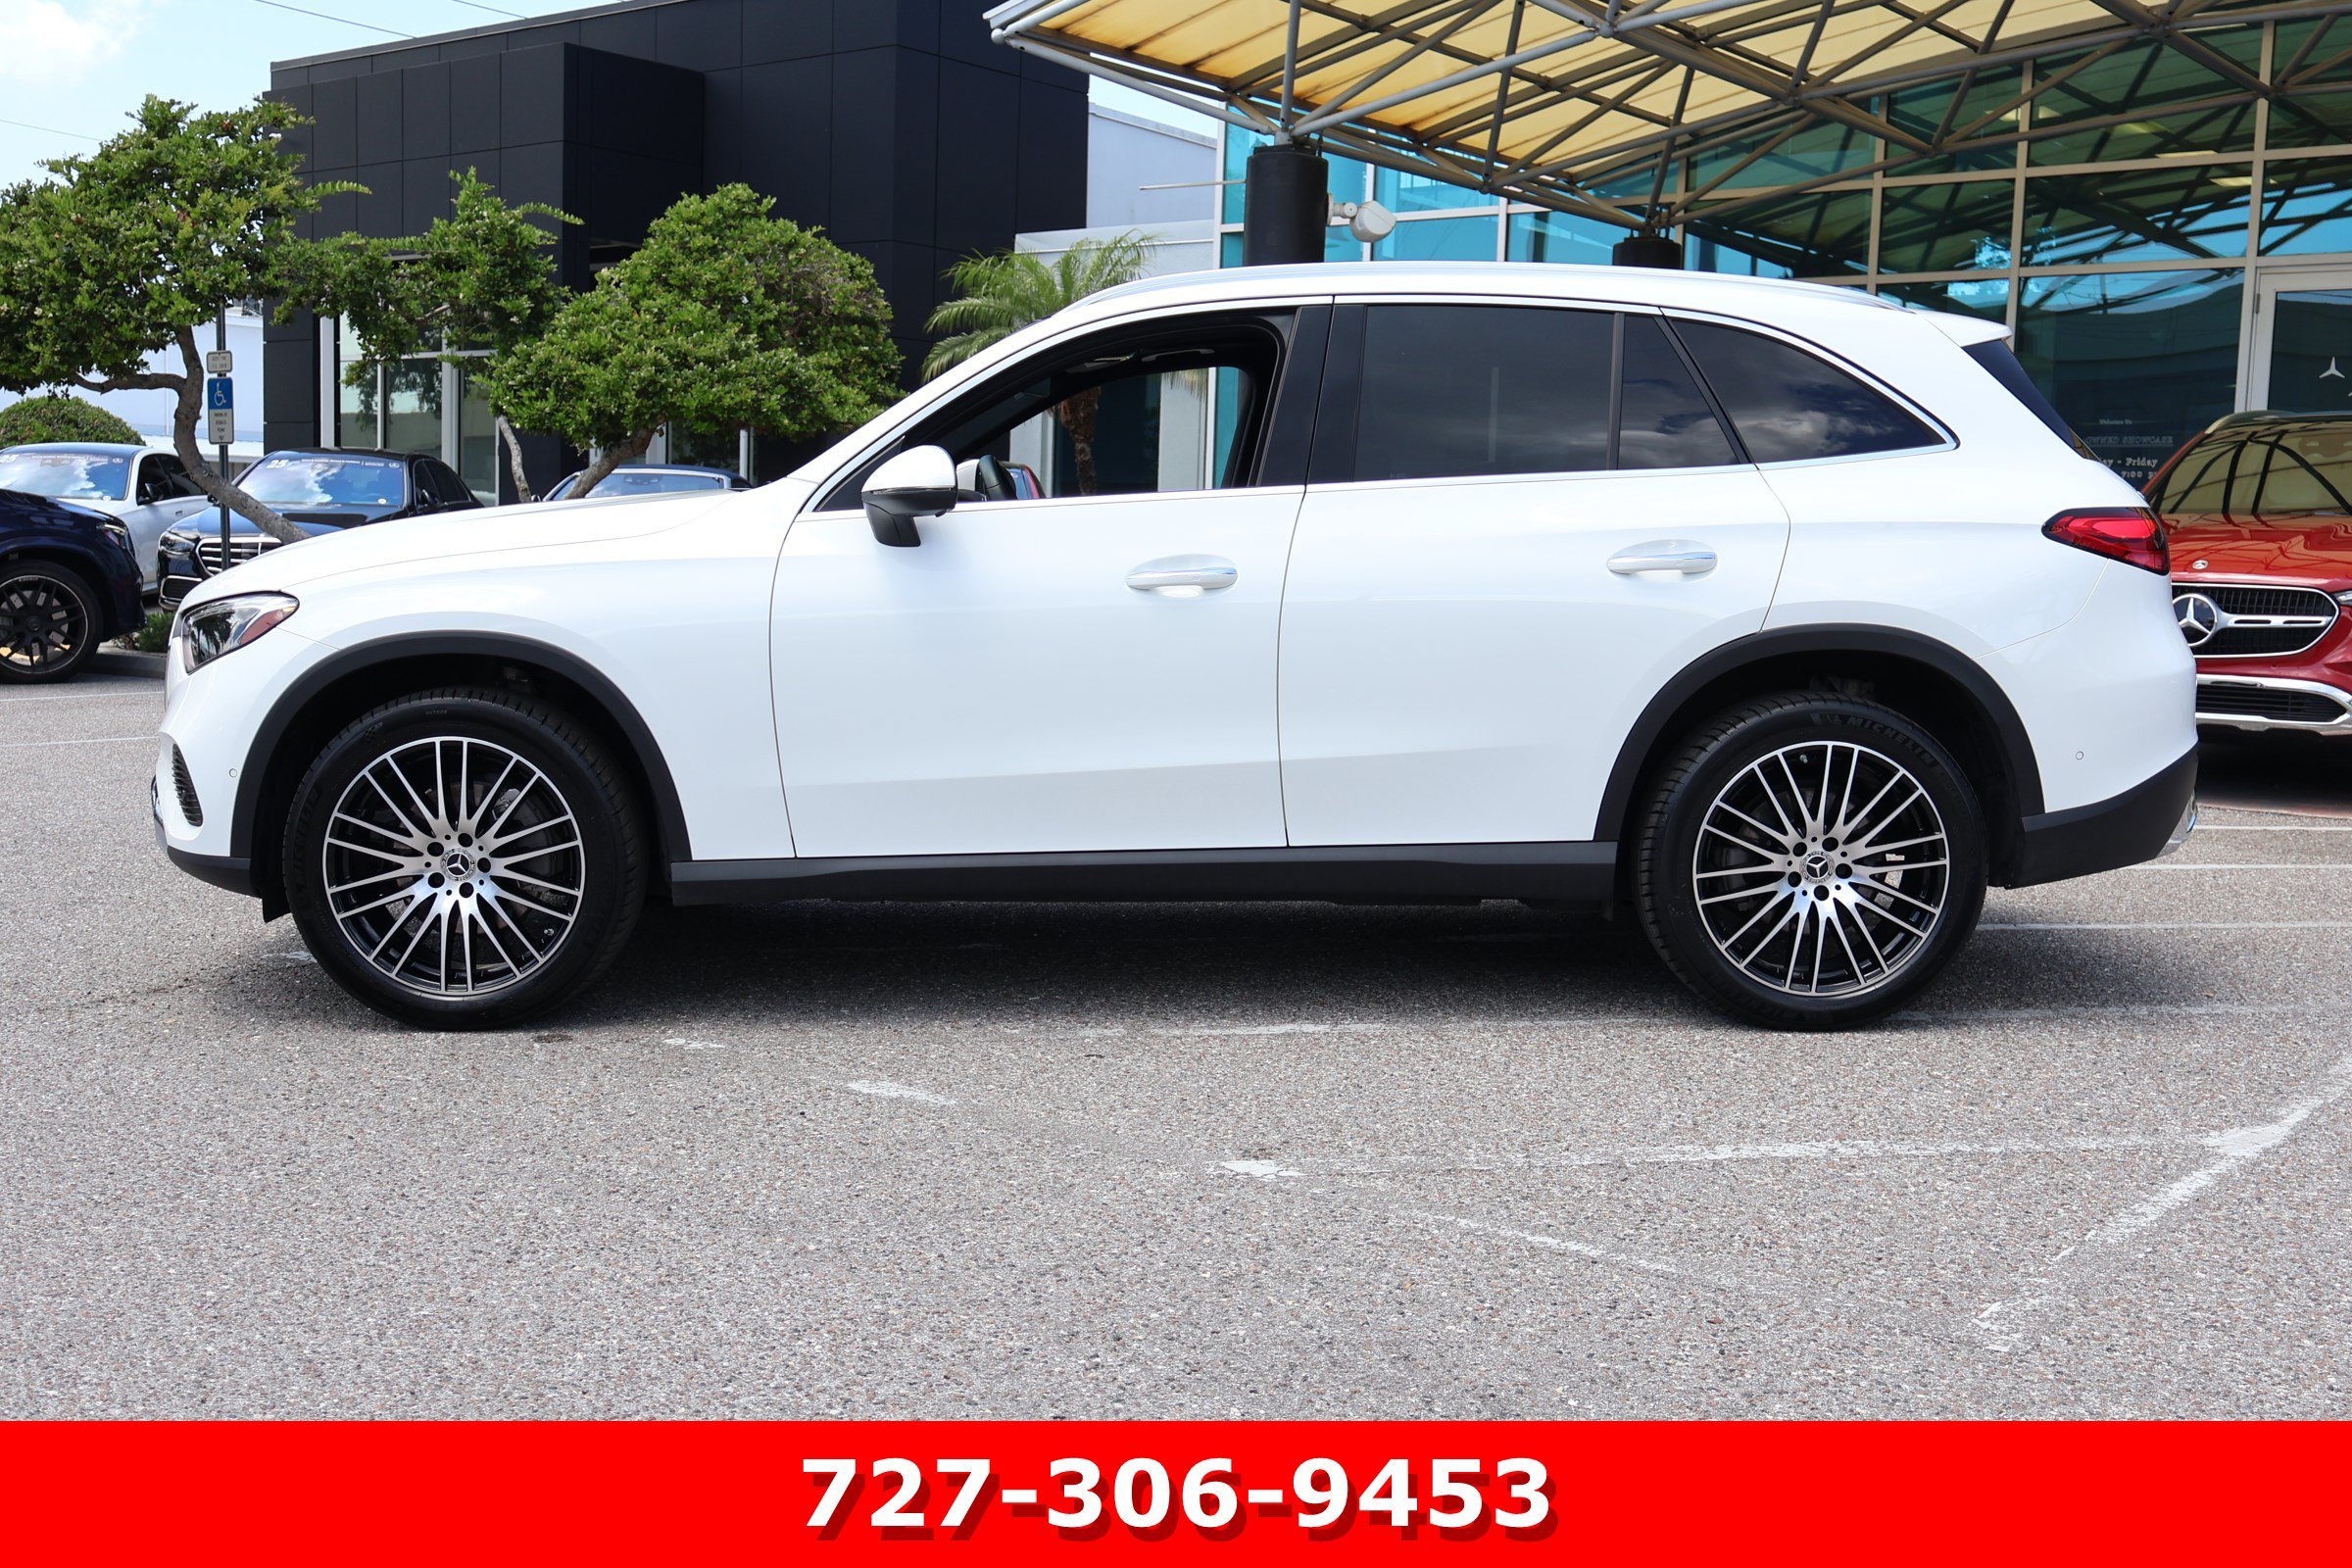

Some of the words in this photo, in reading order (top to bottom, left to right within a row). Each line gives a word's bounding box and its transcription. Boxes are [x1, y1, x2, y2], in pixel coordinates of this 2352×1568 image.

[267, 460, 289, 468] 25
[2125, 457, 2158, 467] Friday
[1846, 715, 1938, 769] MICHELIN
